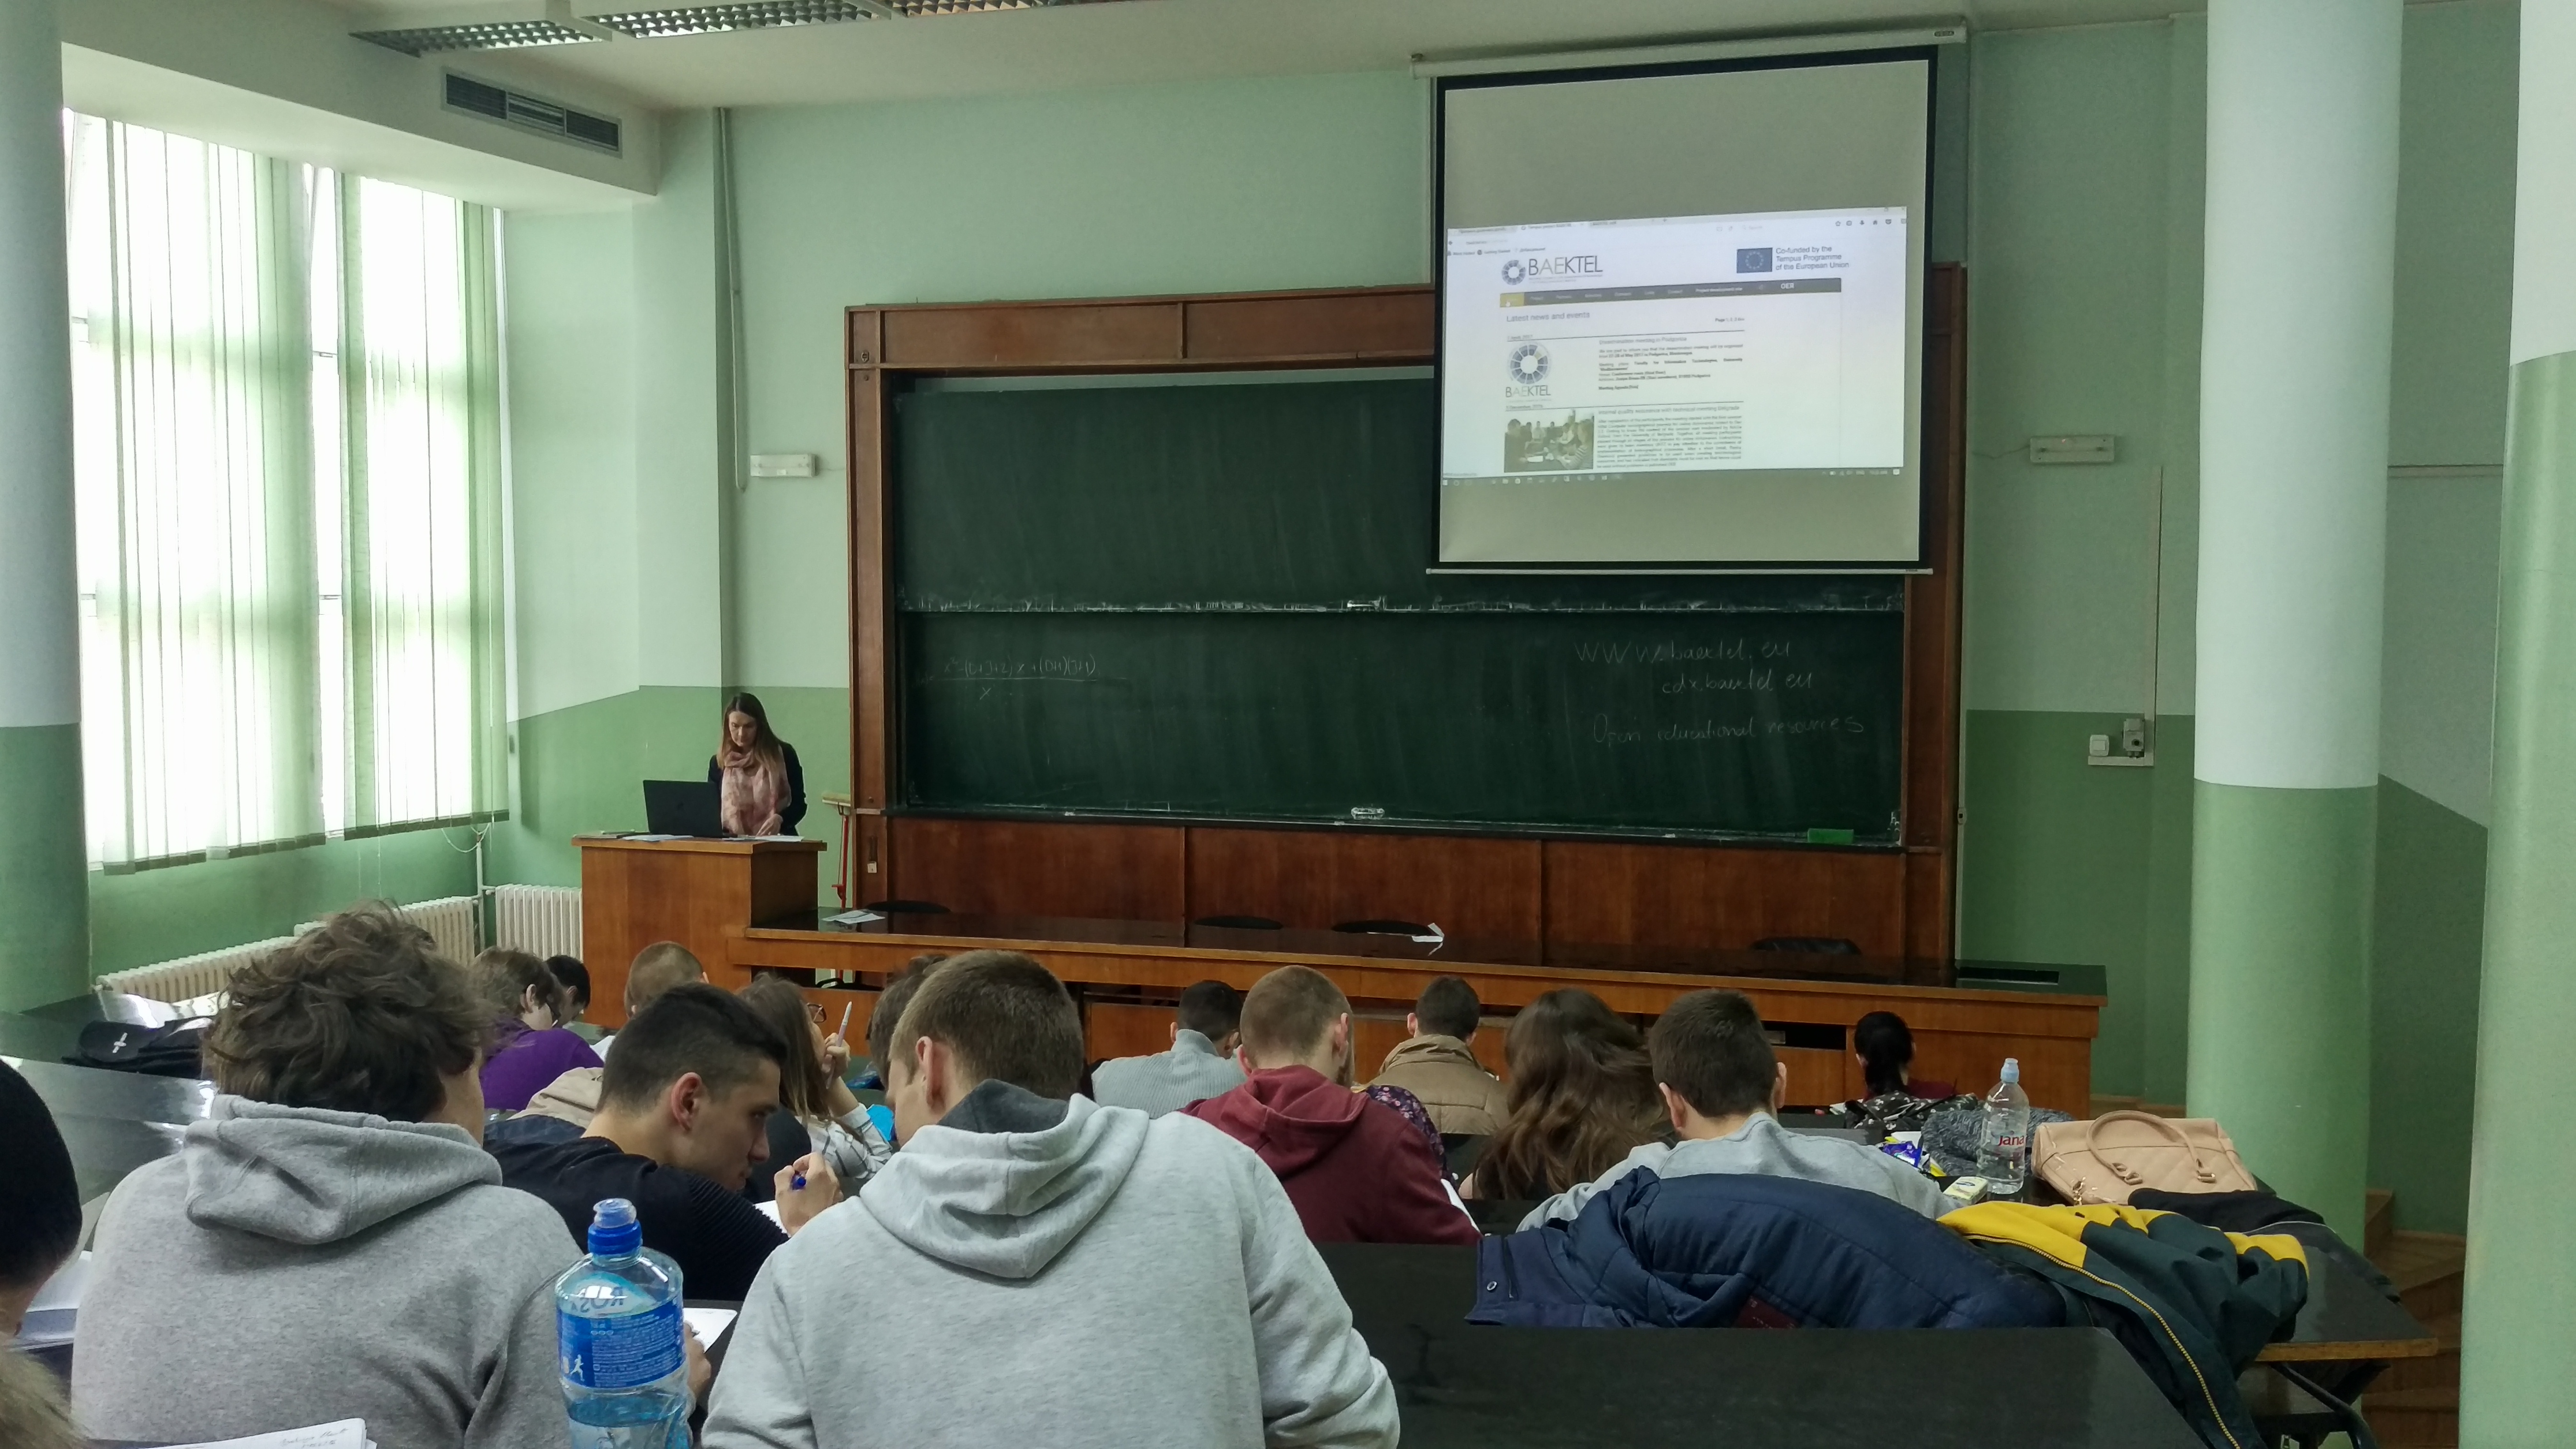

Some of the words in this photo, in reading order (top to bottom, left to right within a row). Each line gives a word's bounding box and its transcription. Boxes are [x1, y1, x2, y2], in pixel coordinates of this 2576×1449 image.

[1528, 255, 1603, 276] BAEKTEL
[1505, 385, 1551, 398] BAEKTEL
[1999, 1135, 2025, 1147] Jana
